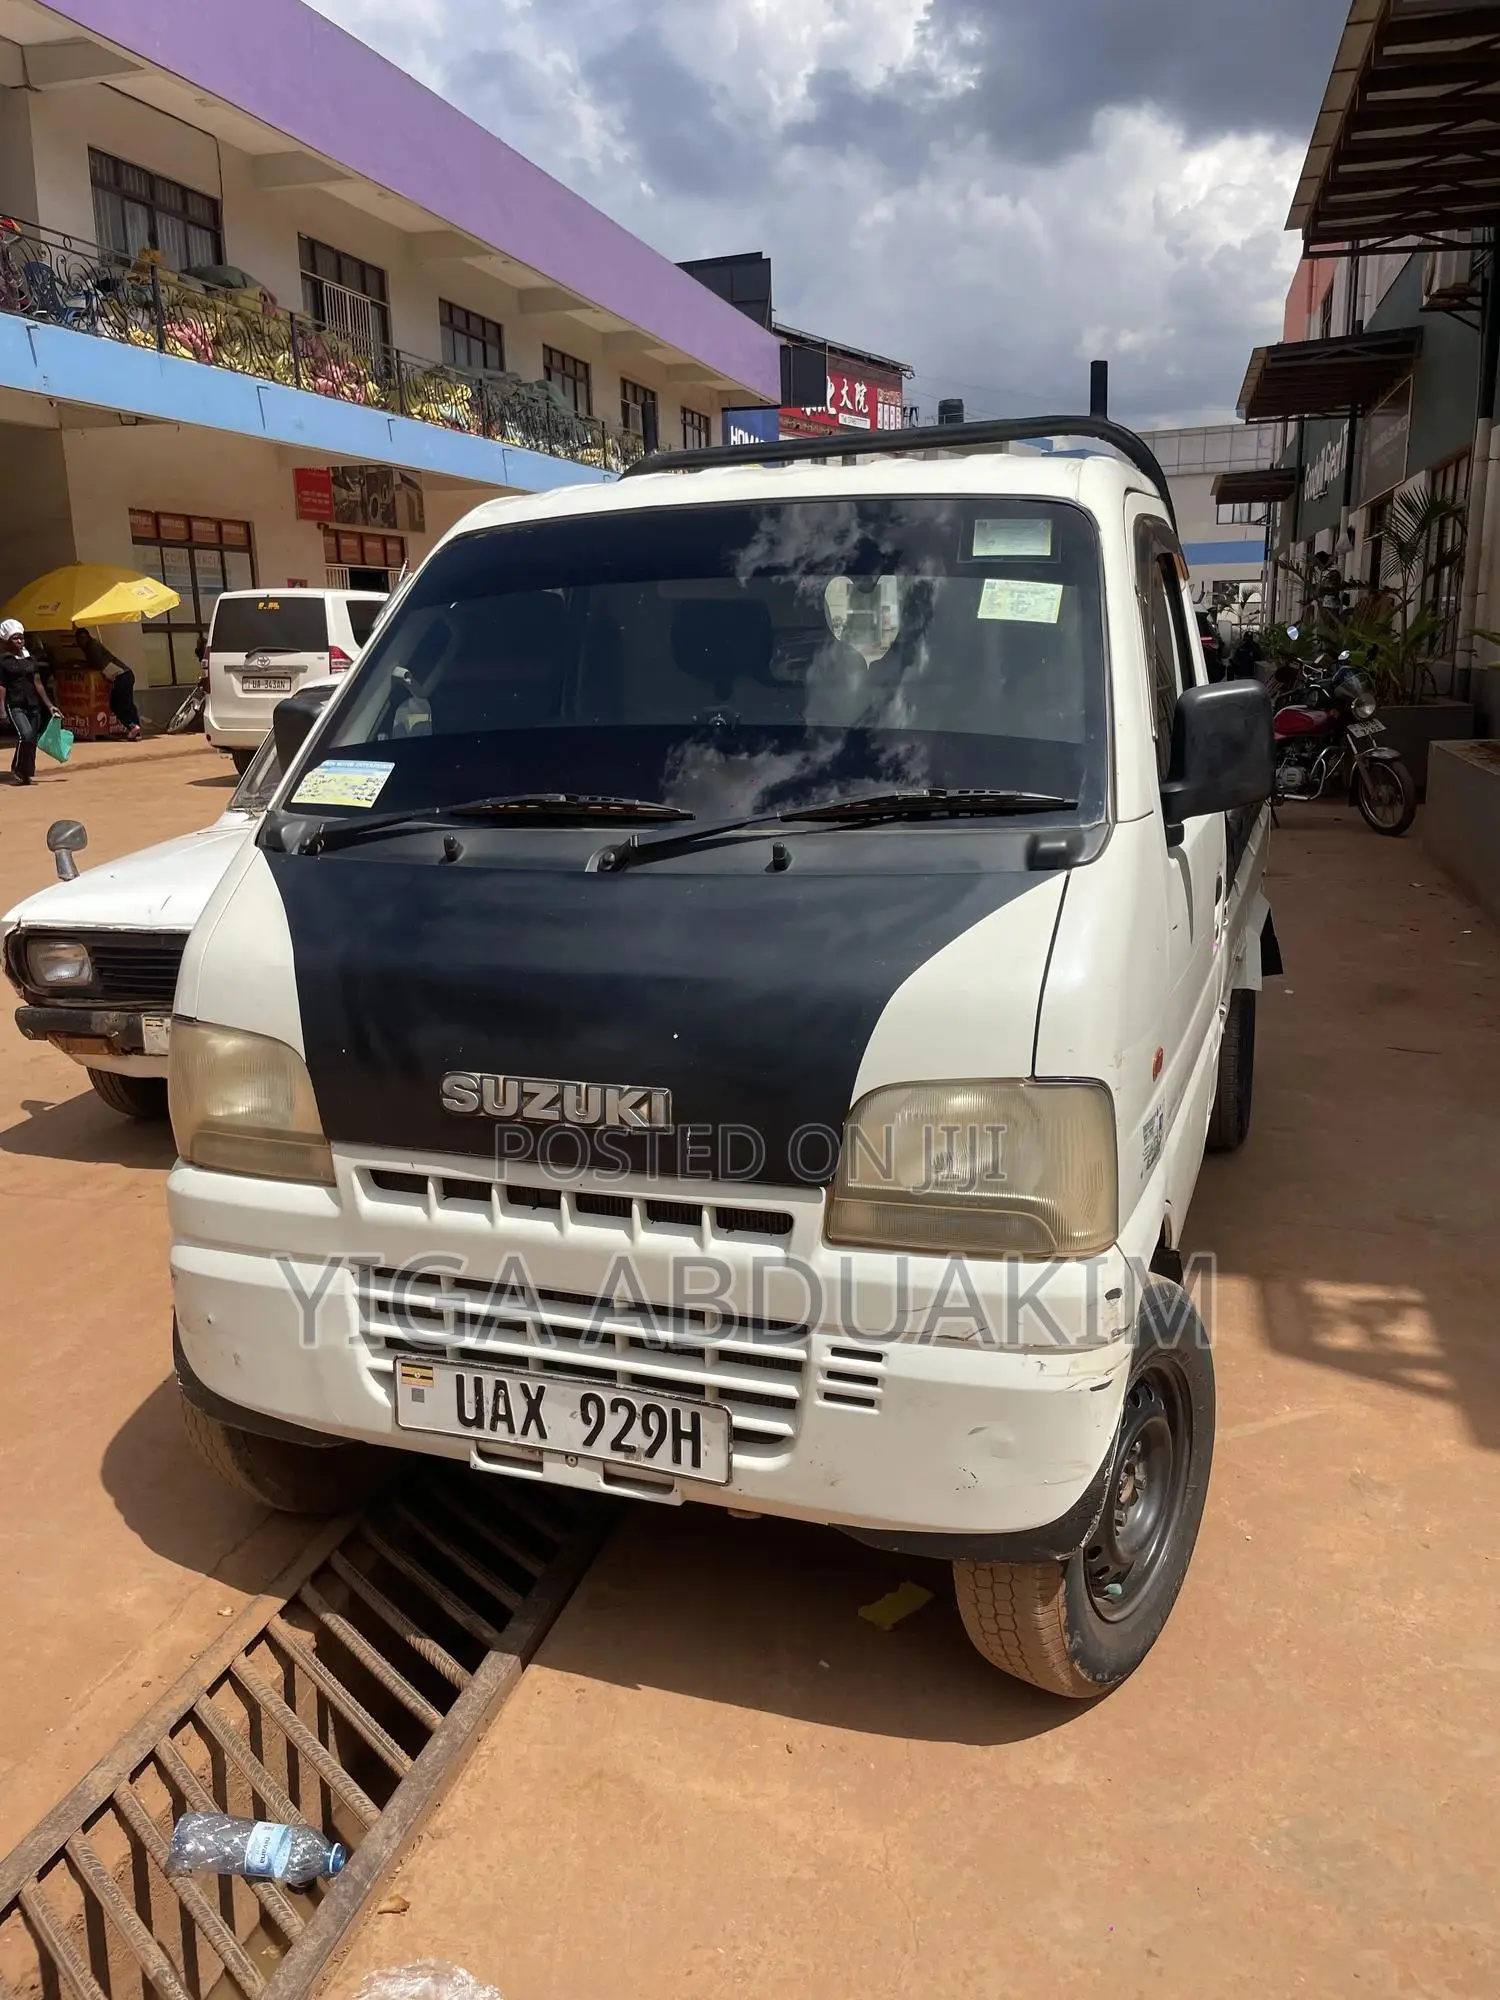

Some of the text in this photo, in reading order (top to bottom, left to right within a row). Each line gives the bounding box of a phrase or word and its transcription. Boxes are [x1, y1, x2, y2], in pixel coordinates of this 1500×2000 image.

[441, 1070, 673, 1134] SUZUKI
[455, 1373, 702, 1469] UAX 929H
